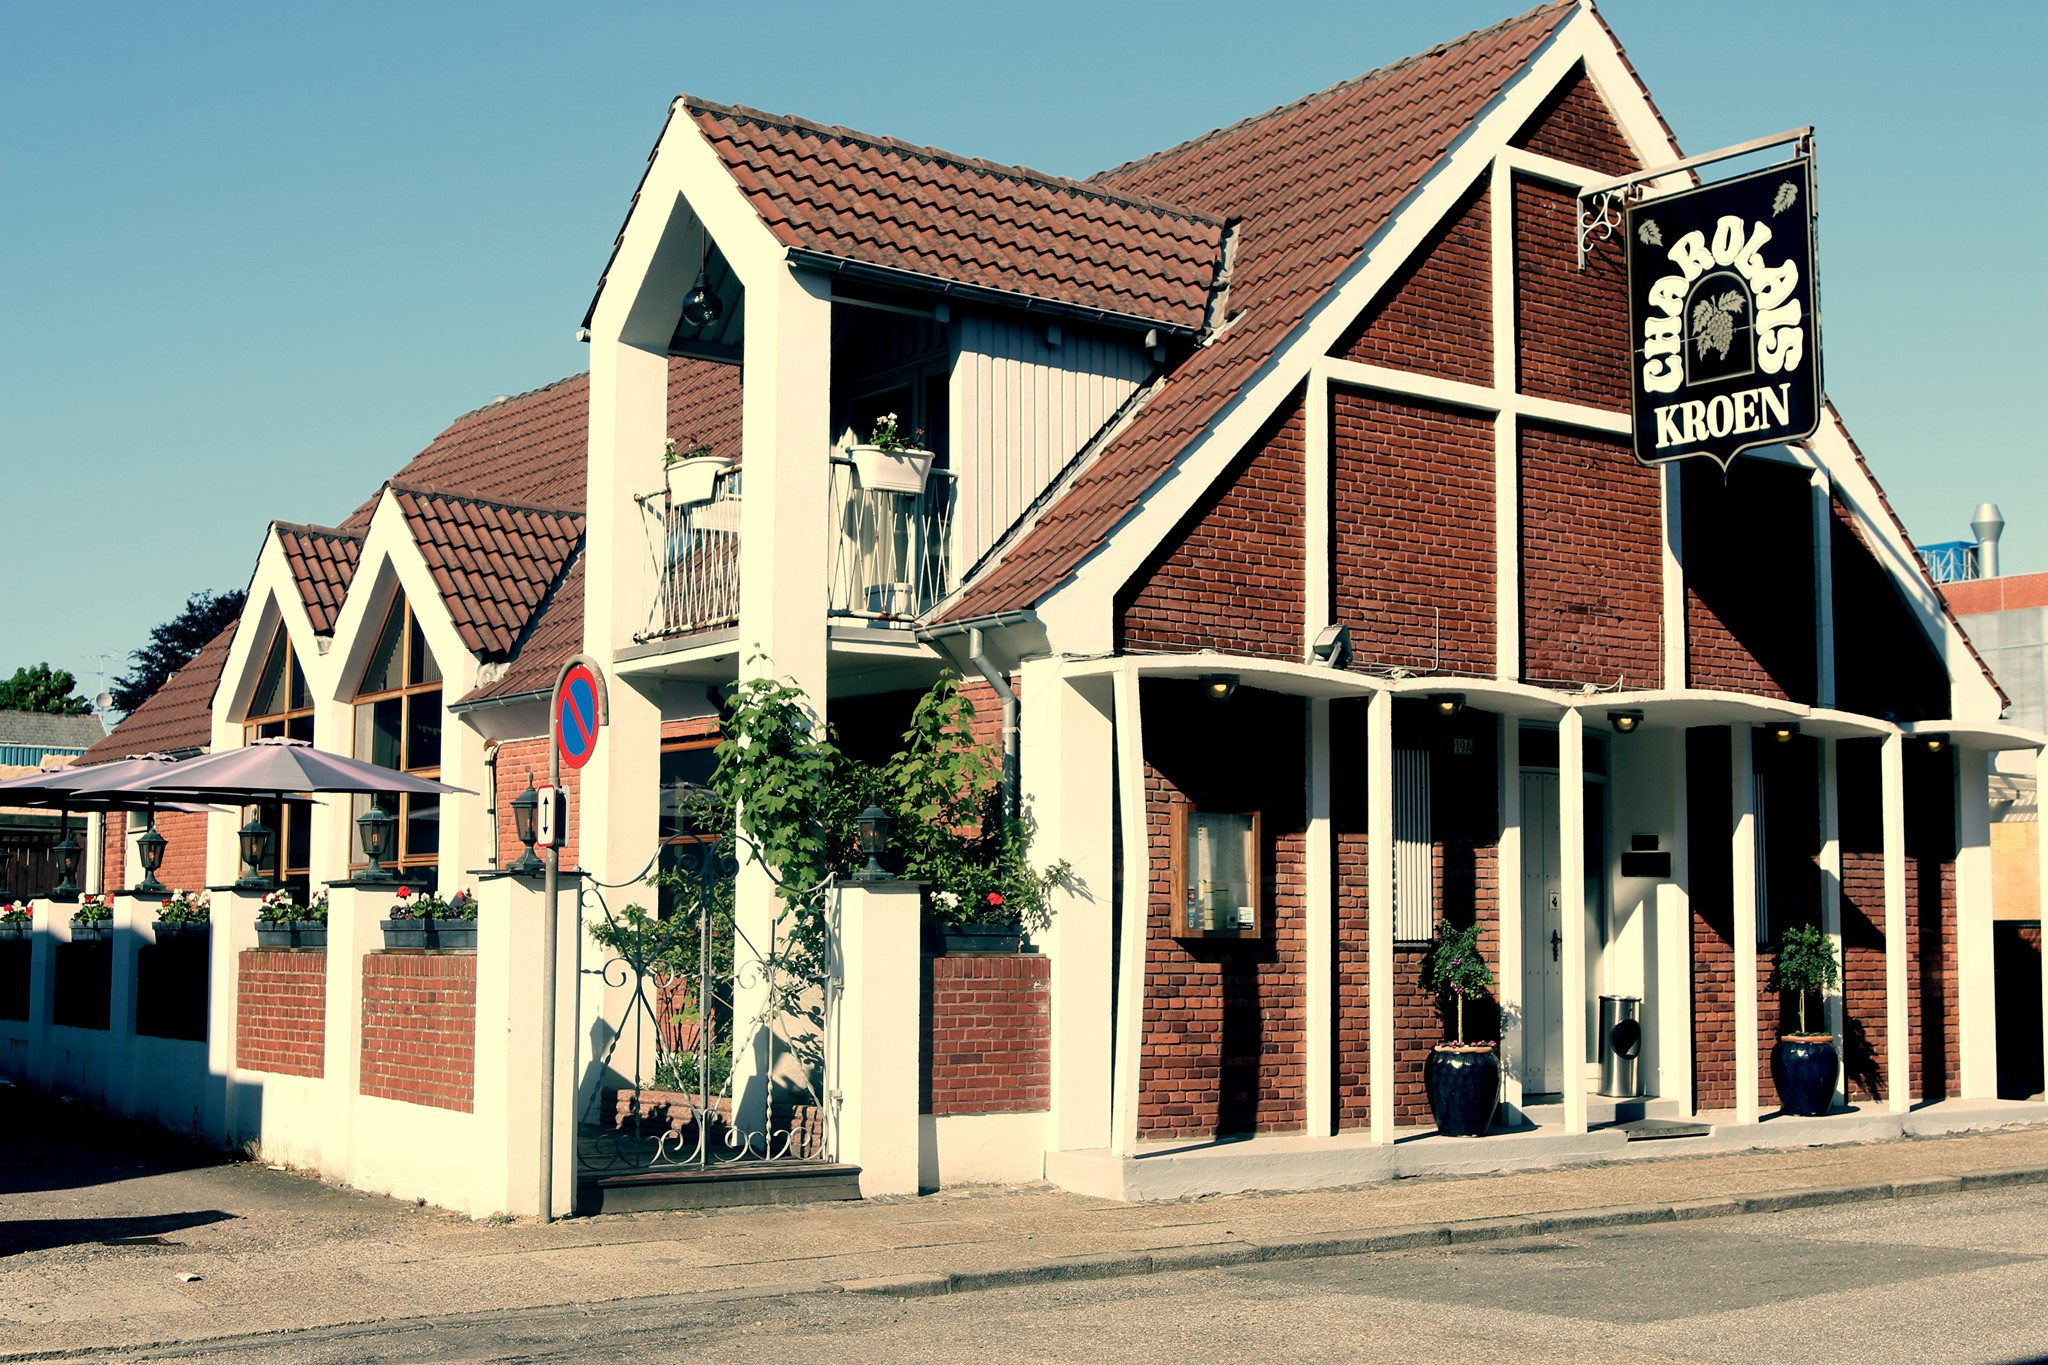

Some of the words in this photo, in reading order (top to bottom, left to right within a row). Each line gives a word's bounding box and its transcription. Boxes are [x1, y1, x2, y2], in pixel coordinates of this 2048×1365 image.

[1643, 215, 1803, 393] CHAROLAIS
[1654, 382, 1791, 449] KROEN
[1456, 739, 1473, 753] 19A
